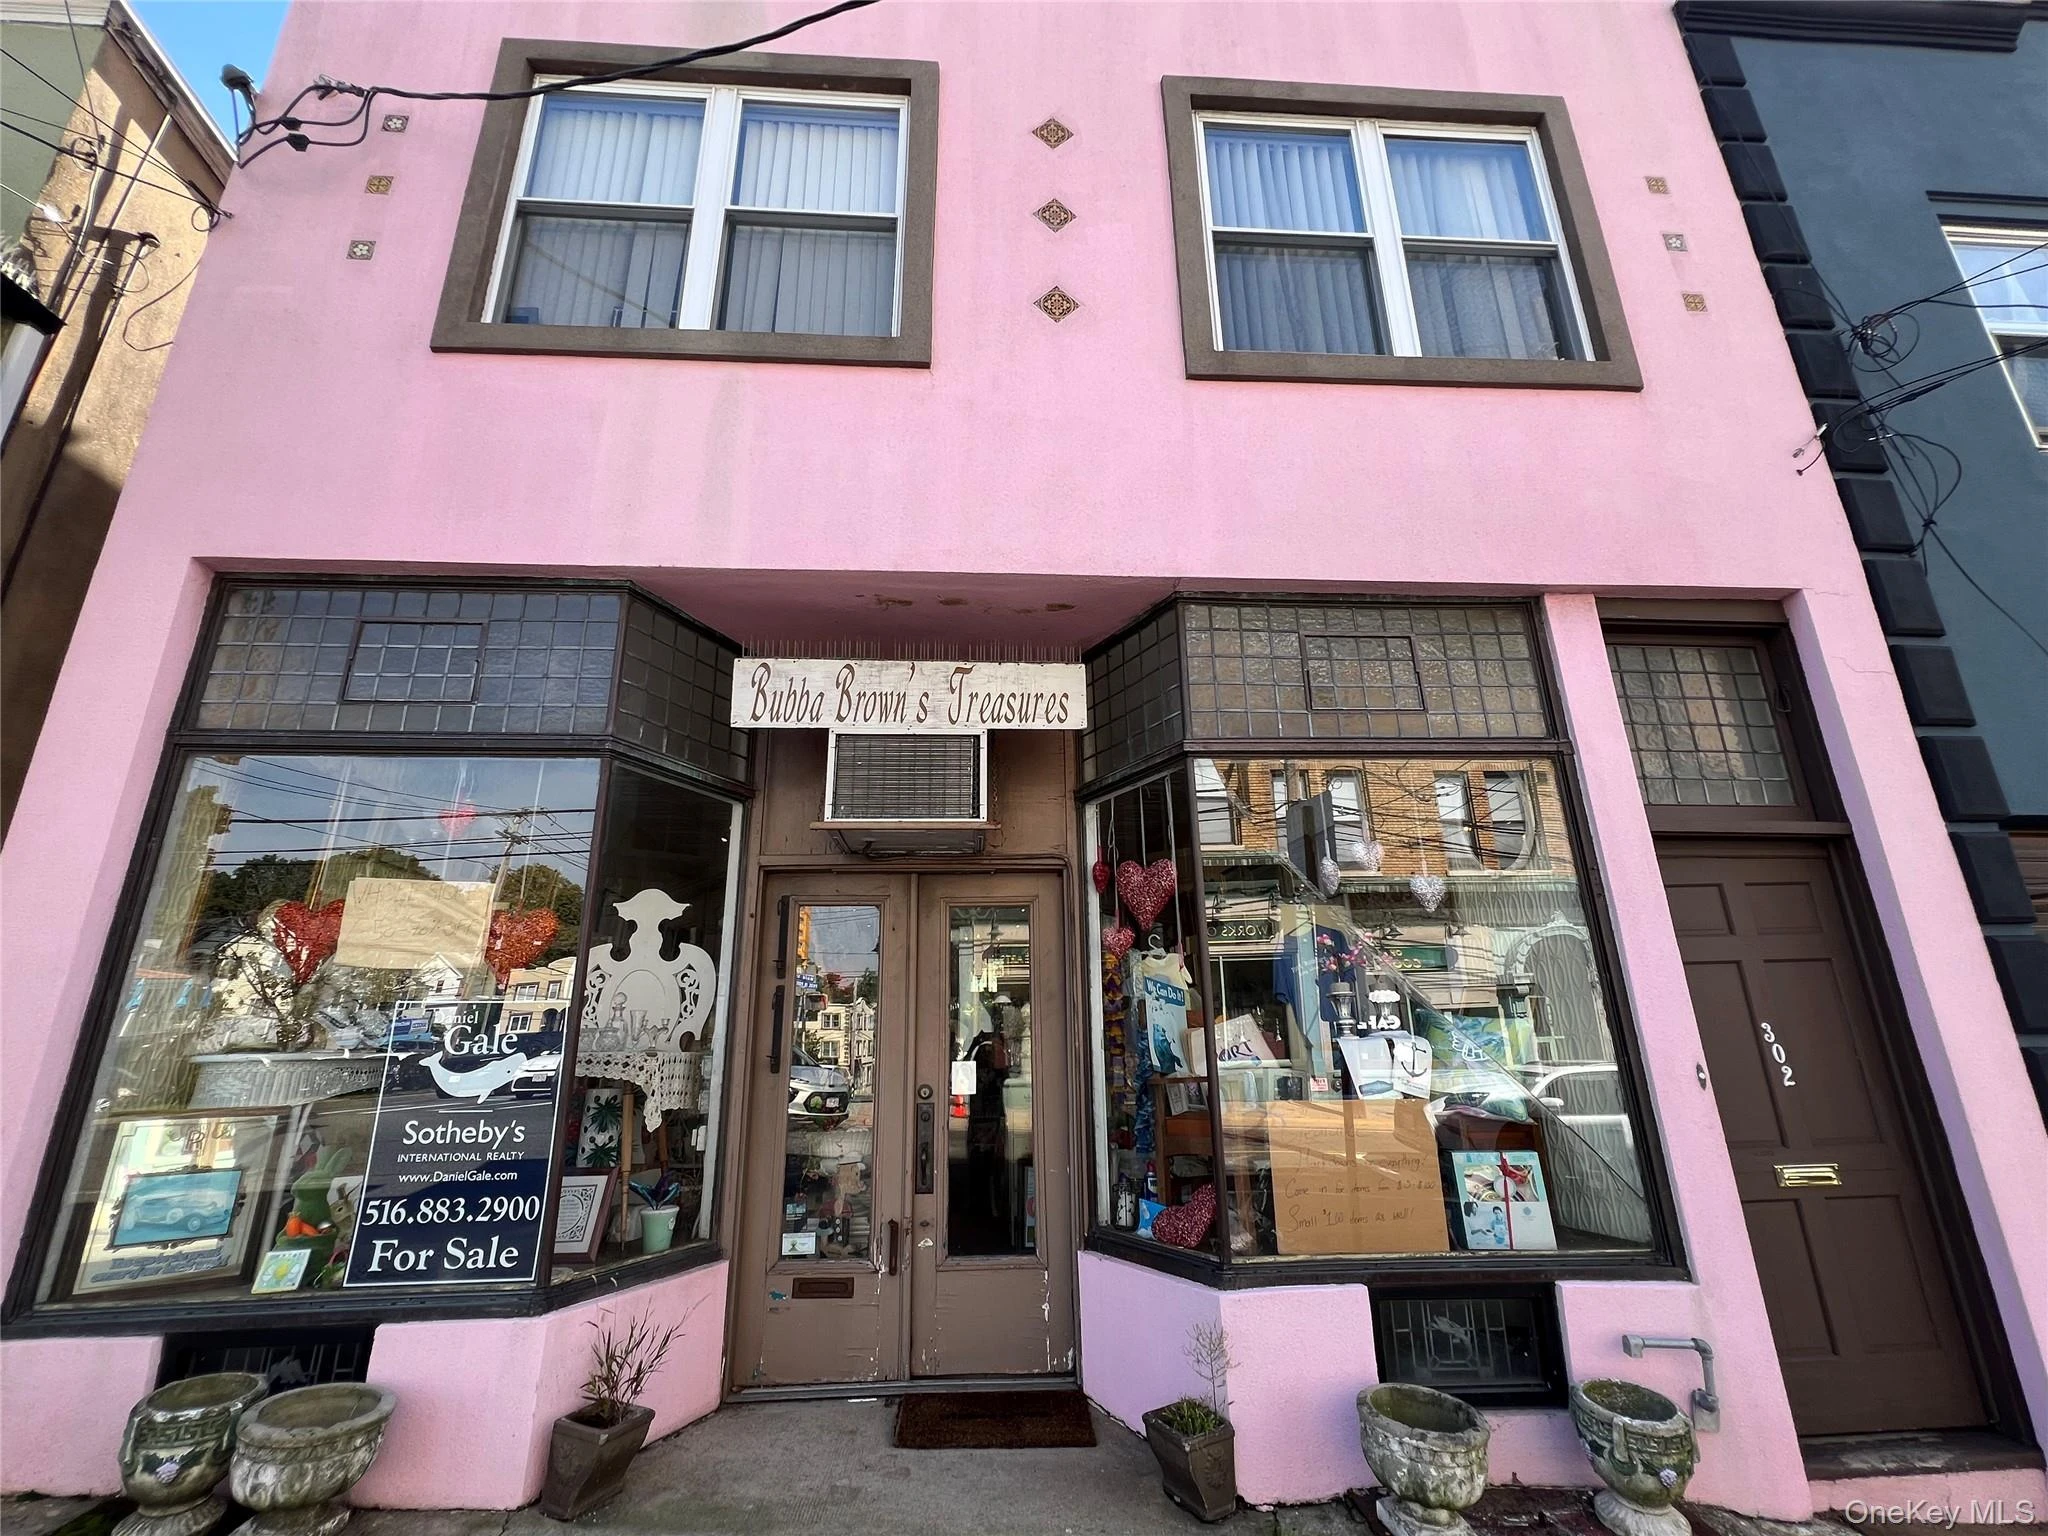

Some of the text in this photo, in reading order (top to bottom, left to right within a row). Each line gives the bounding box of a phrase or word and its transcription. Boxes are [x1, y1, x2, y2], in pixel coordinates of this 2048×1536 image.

[749, 661, 1070, 725] Bubba Brown's Treasures
[1167, 986, 1177, 1000] Do
[434, 1010, 478, 1024] Daniel
[444, 1023, 518, 1055] Gale
[1760, 1022, 1797, 1087] 302
[402, 1119, 526, 1149] Sotheby's
[397, 1151, 525, 1163] INTERNATIONAL REALTY
[398, 1170, 518, 1183] www.DanielGale.com
[362, 1195, 540, 1226] 516.883.2900
[367, 1235, 519, 1272] For Sale
